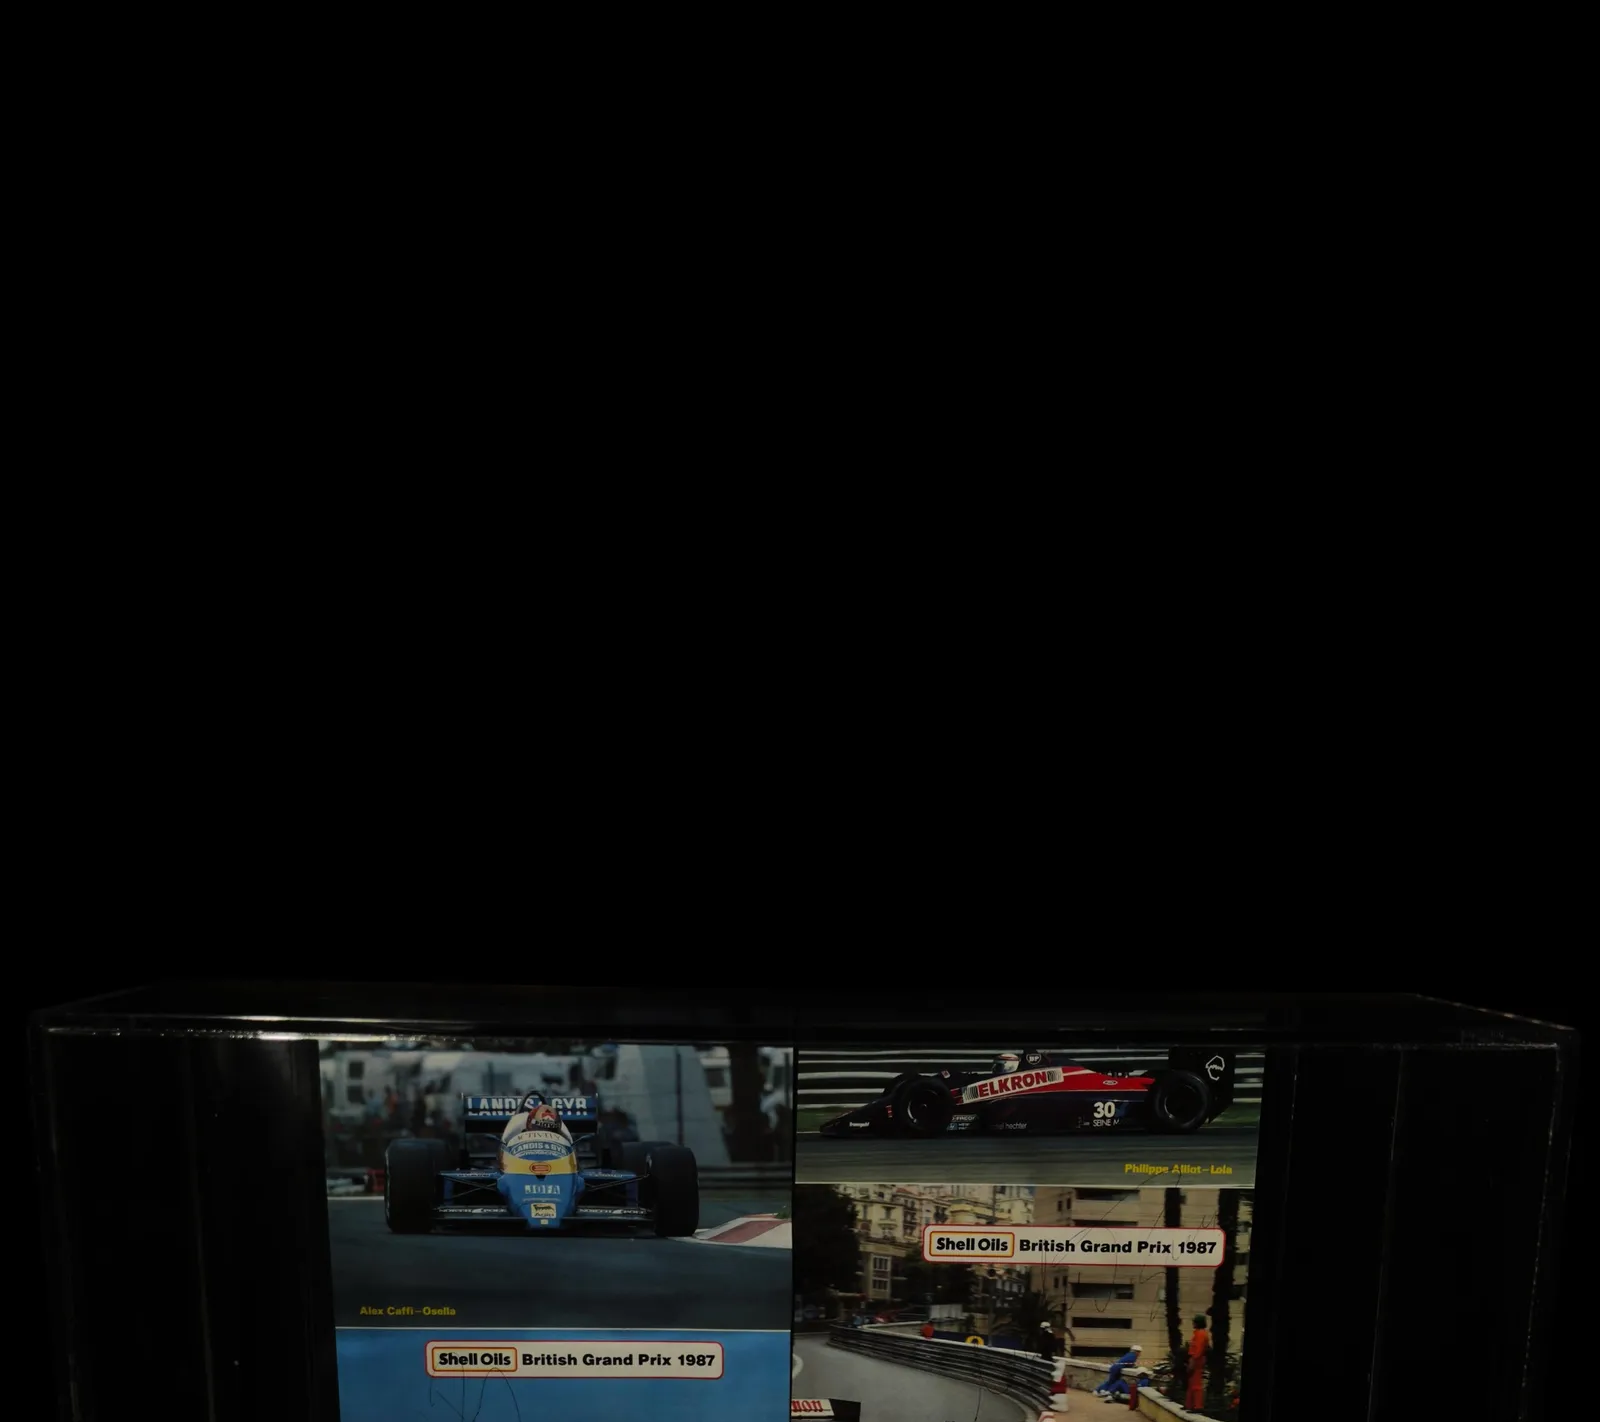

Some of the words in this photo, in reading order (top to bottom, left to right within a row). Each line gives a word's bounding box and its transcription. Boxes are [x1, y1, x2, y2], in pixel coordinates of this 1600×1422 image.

[977, 1071, 1048, 1098] ELKRON
[1093, 1102, 1116, 1119] 30
[1124, 1163, 1169, 1175] Philippe
[936, 1237, 975, 1251] Shell
[978, 1238, 1008, 1251] Oils
[1019, 1239, 1075, 1252] British
[1080, 1240, 1132, 1253] Grand
[1137, 1241, 1171, 1254] Prix
[1178, 1241, 1217, 1254] 1987
[359, 1305, 384, 1316] Alex
[438, 1353, 478, 1366] Shell
[480, 1353, 511, 1366] Oils
[522, 1353, 577, 1366] British
[582, 1353, 633, 1366] Grand
[638, 1354, 671, 1366] Prix
[677, 1354, 715, 1366] 1987
